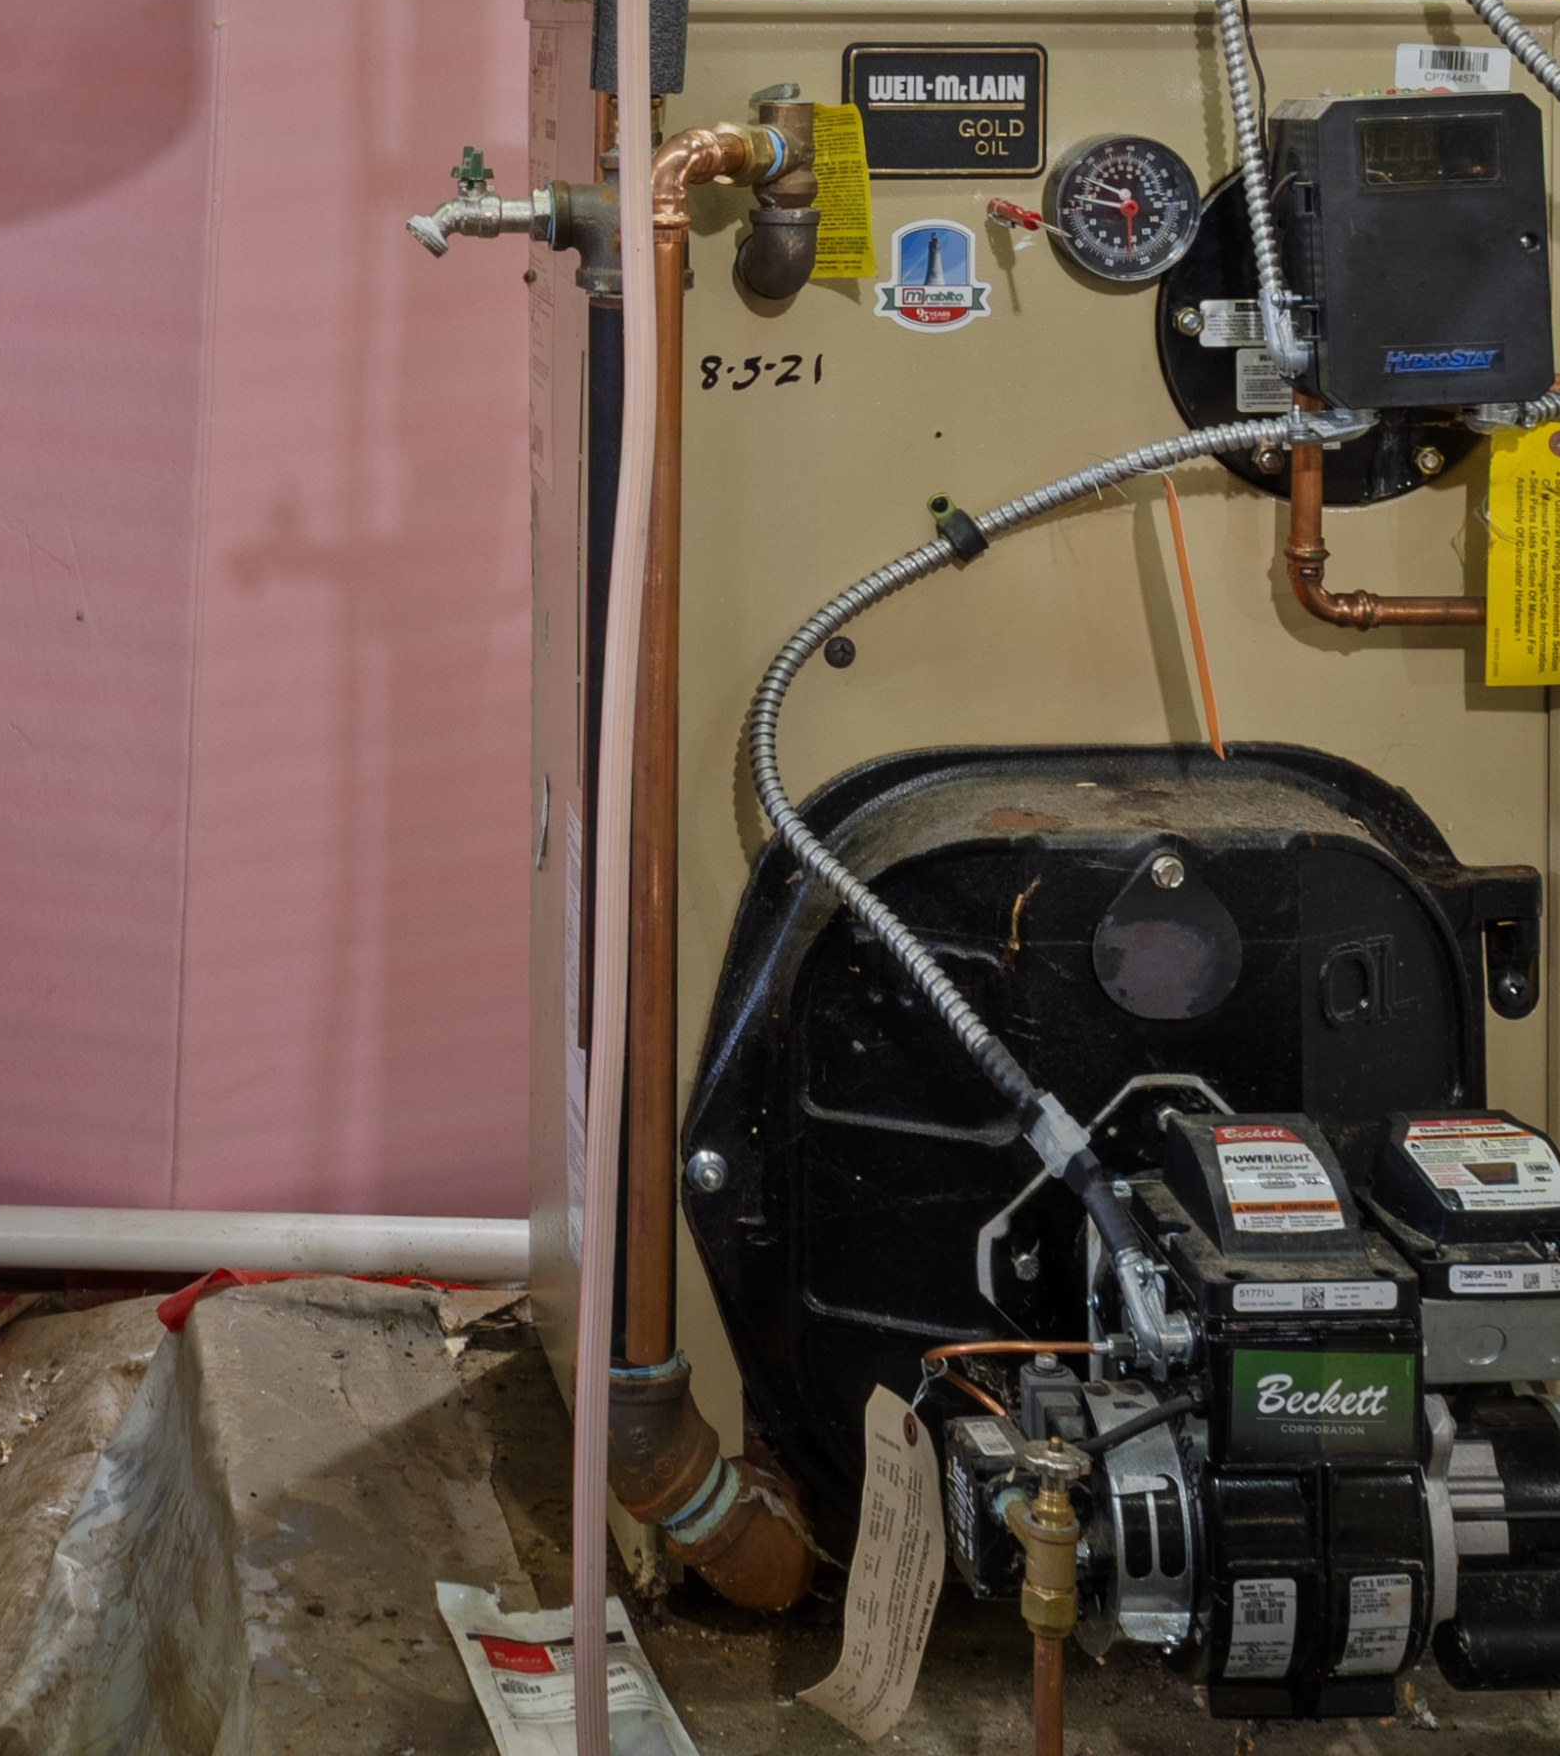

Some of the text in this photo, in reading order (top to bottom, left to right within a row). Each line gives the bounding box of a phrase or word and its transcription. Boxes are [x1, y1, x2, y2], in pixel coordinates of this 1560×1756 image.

[958, 119, 1025, 137] GOLD
[975, 140, 1009, 155] OIL
[1514, 477, 1524, 636] Assembly Of Circulator Hardware.
[1539, 494, 1550, 620] Manual For Warnings/Code
[1527, 477, 1537, 655] See Parts Lists Section Of Manual For
[1552, 574, 1560, 637] Requirements
[1552, 641, 1560, 671] Section
[1220, 1128, 1285, 1139] Beckett
[1224, 1153, 1311, 1164] POWERLIGHT
[1239, 1289, 1274, 1298] 51771U
[1257, 1373, 1388, 1416] Beckett
[1280, 1424, 1365, 1435] CORPORATION
[1351, 1578, 1411, 1588] MFG'S SETTINGS
